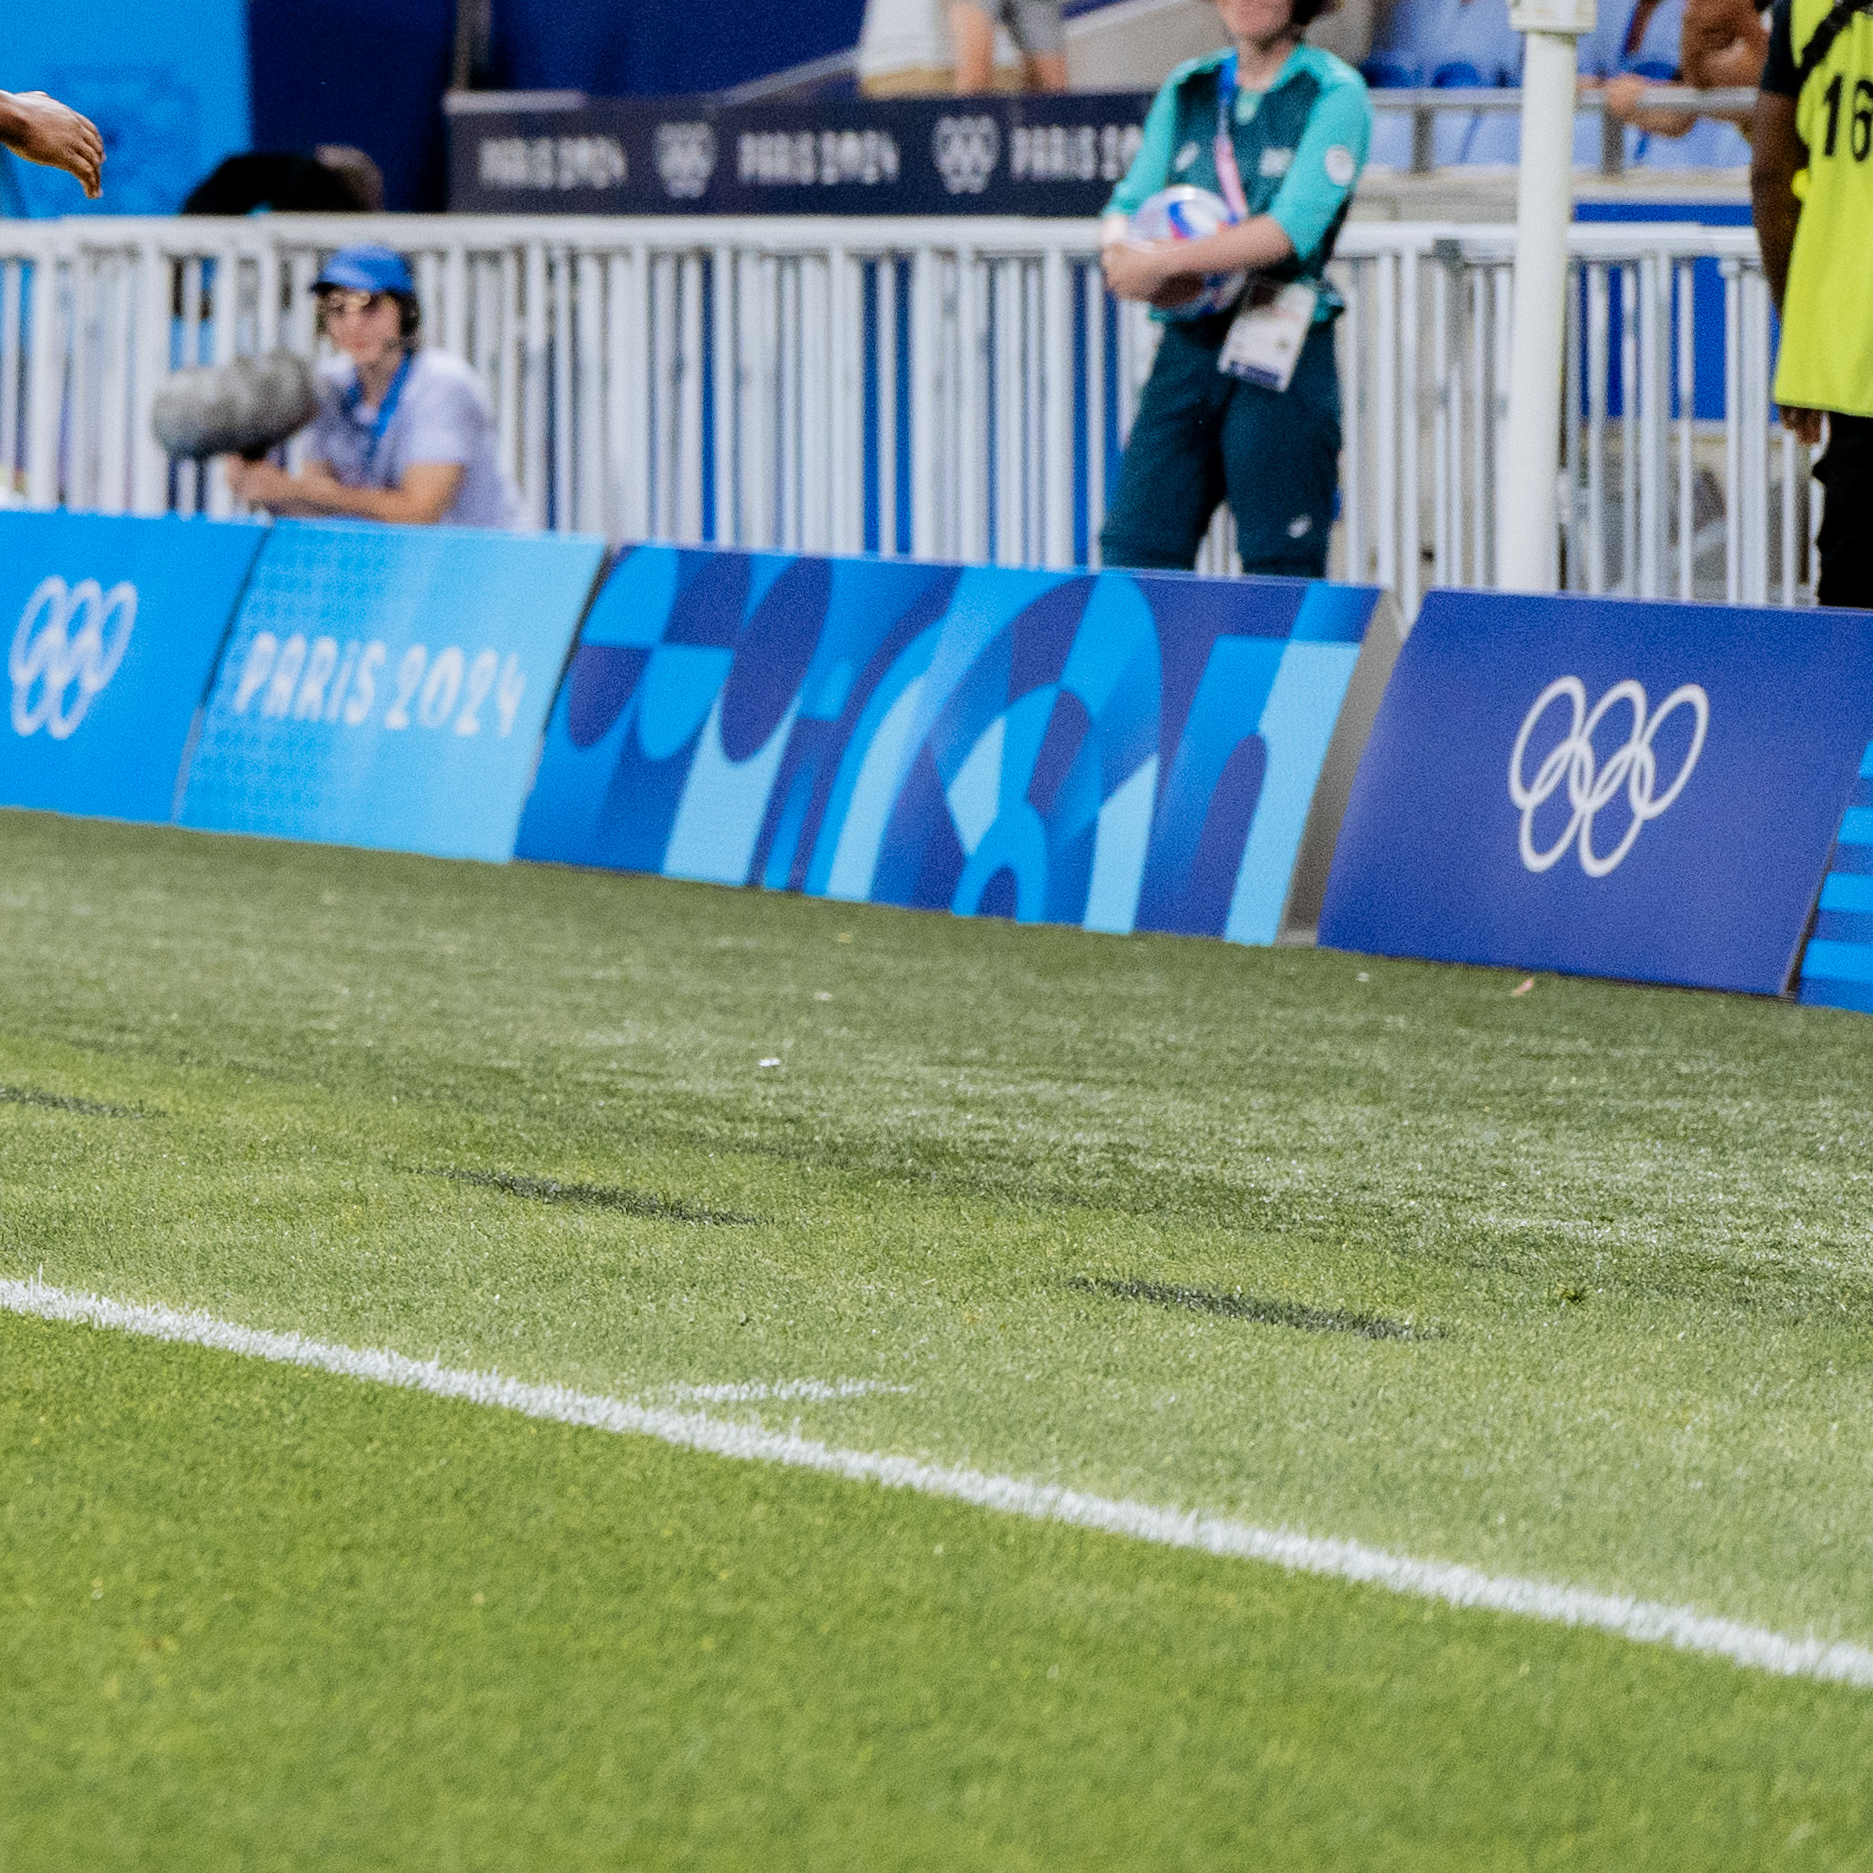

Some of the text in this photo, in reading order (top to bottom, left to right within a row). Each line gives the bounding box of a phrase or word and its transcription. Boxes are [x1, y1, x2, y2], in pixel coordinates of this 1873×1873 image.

[1823, 73, 1873, 162] 16
[738, 130, 900, 185] PARIS 2024
[1011, 127, 1097, 181] PARIS
[384, 643, 527, 739] 2024
